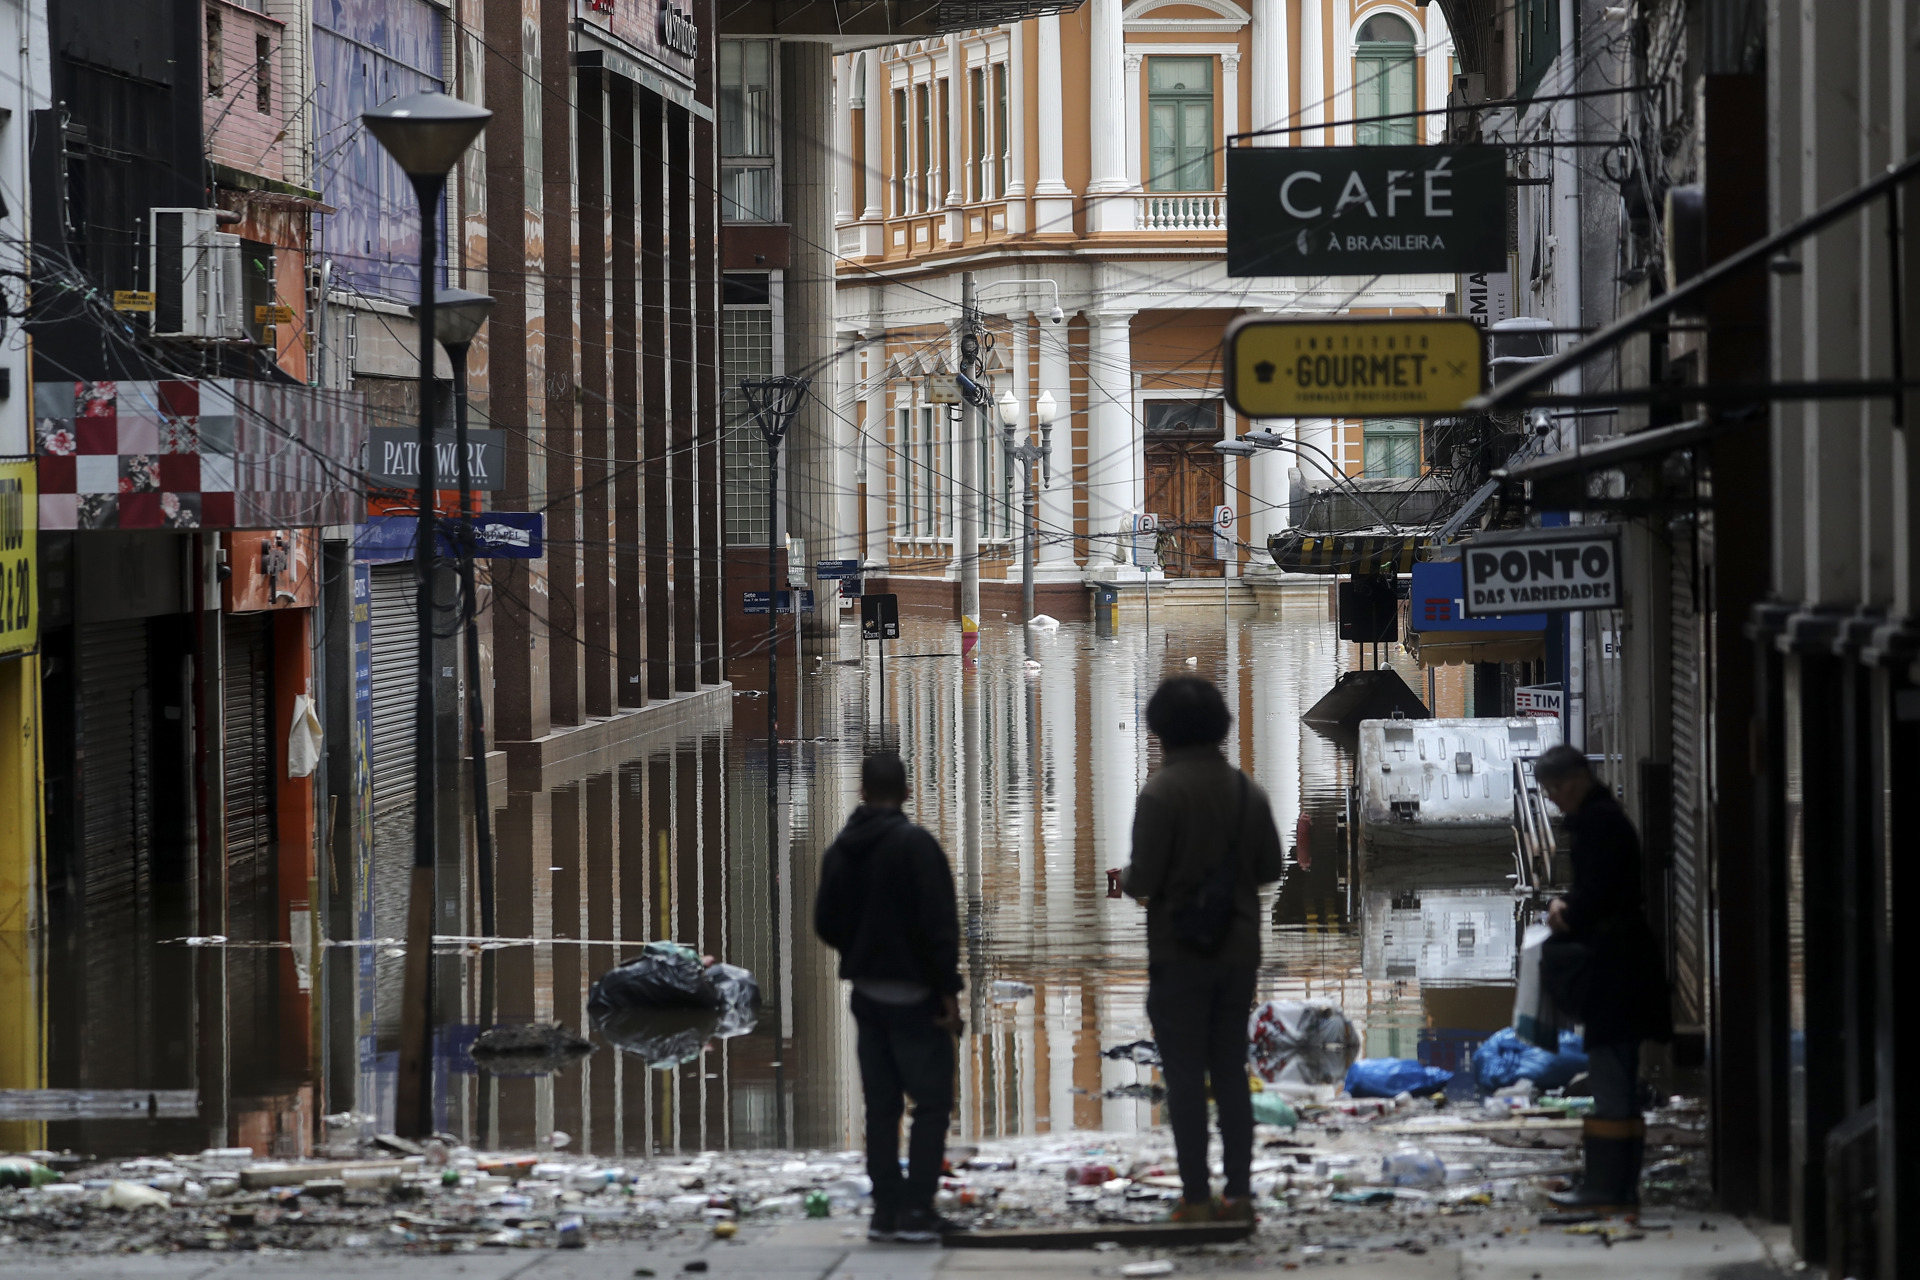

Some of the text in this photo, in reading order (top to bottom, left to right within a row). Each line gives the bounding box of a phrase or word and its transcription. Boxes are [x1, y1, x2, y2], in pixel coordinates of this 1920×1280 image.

[1279, 156, 1453, 219] CAFÉ
[1328, 231, 1445, 251] À BRASILEIRA
[1295, 334, 1430, 350] INSTITUTO
[1295, 353, 1429, 388] GOURMET
[1223, 511, 1229, 524] E
[1471, 545, 1610, 585] PONTO
[1474, 582, 1611, 605] DAS VARIEDADES
[1533, 693, 1561, 709] TIM
